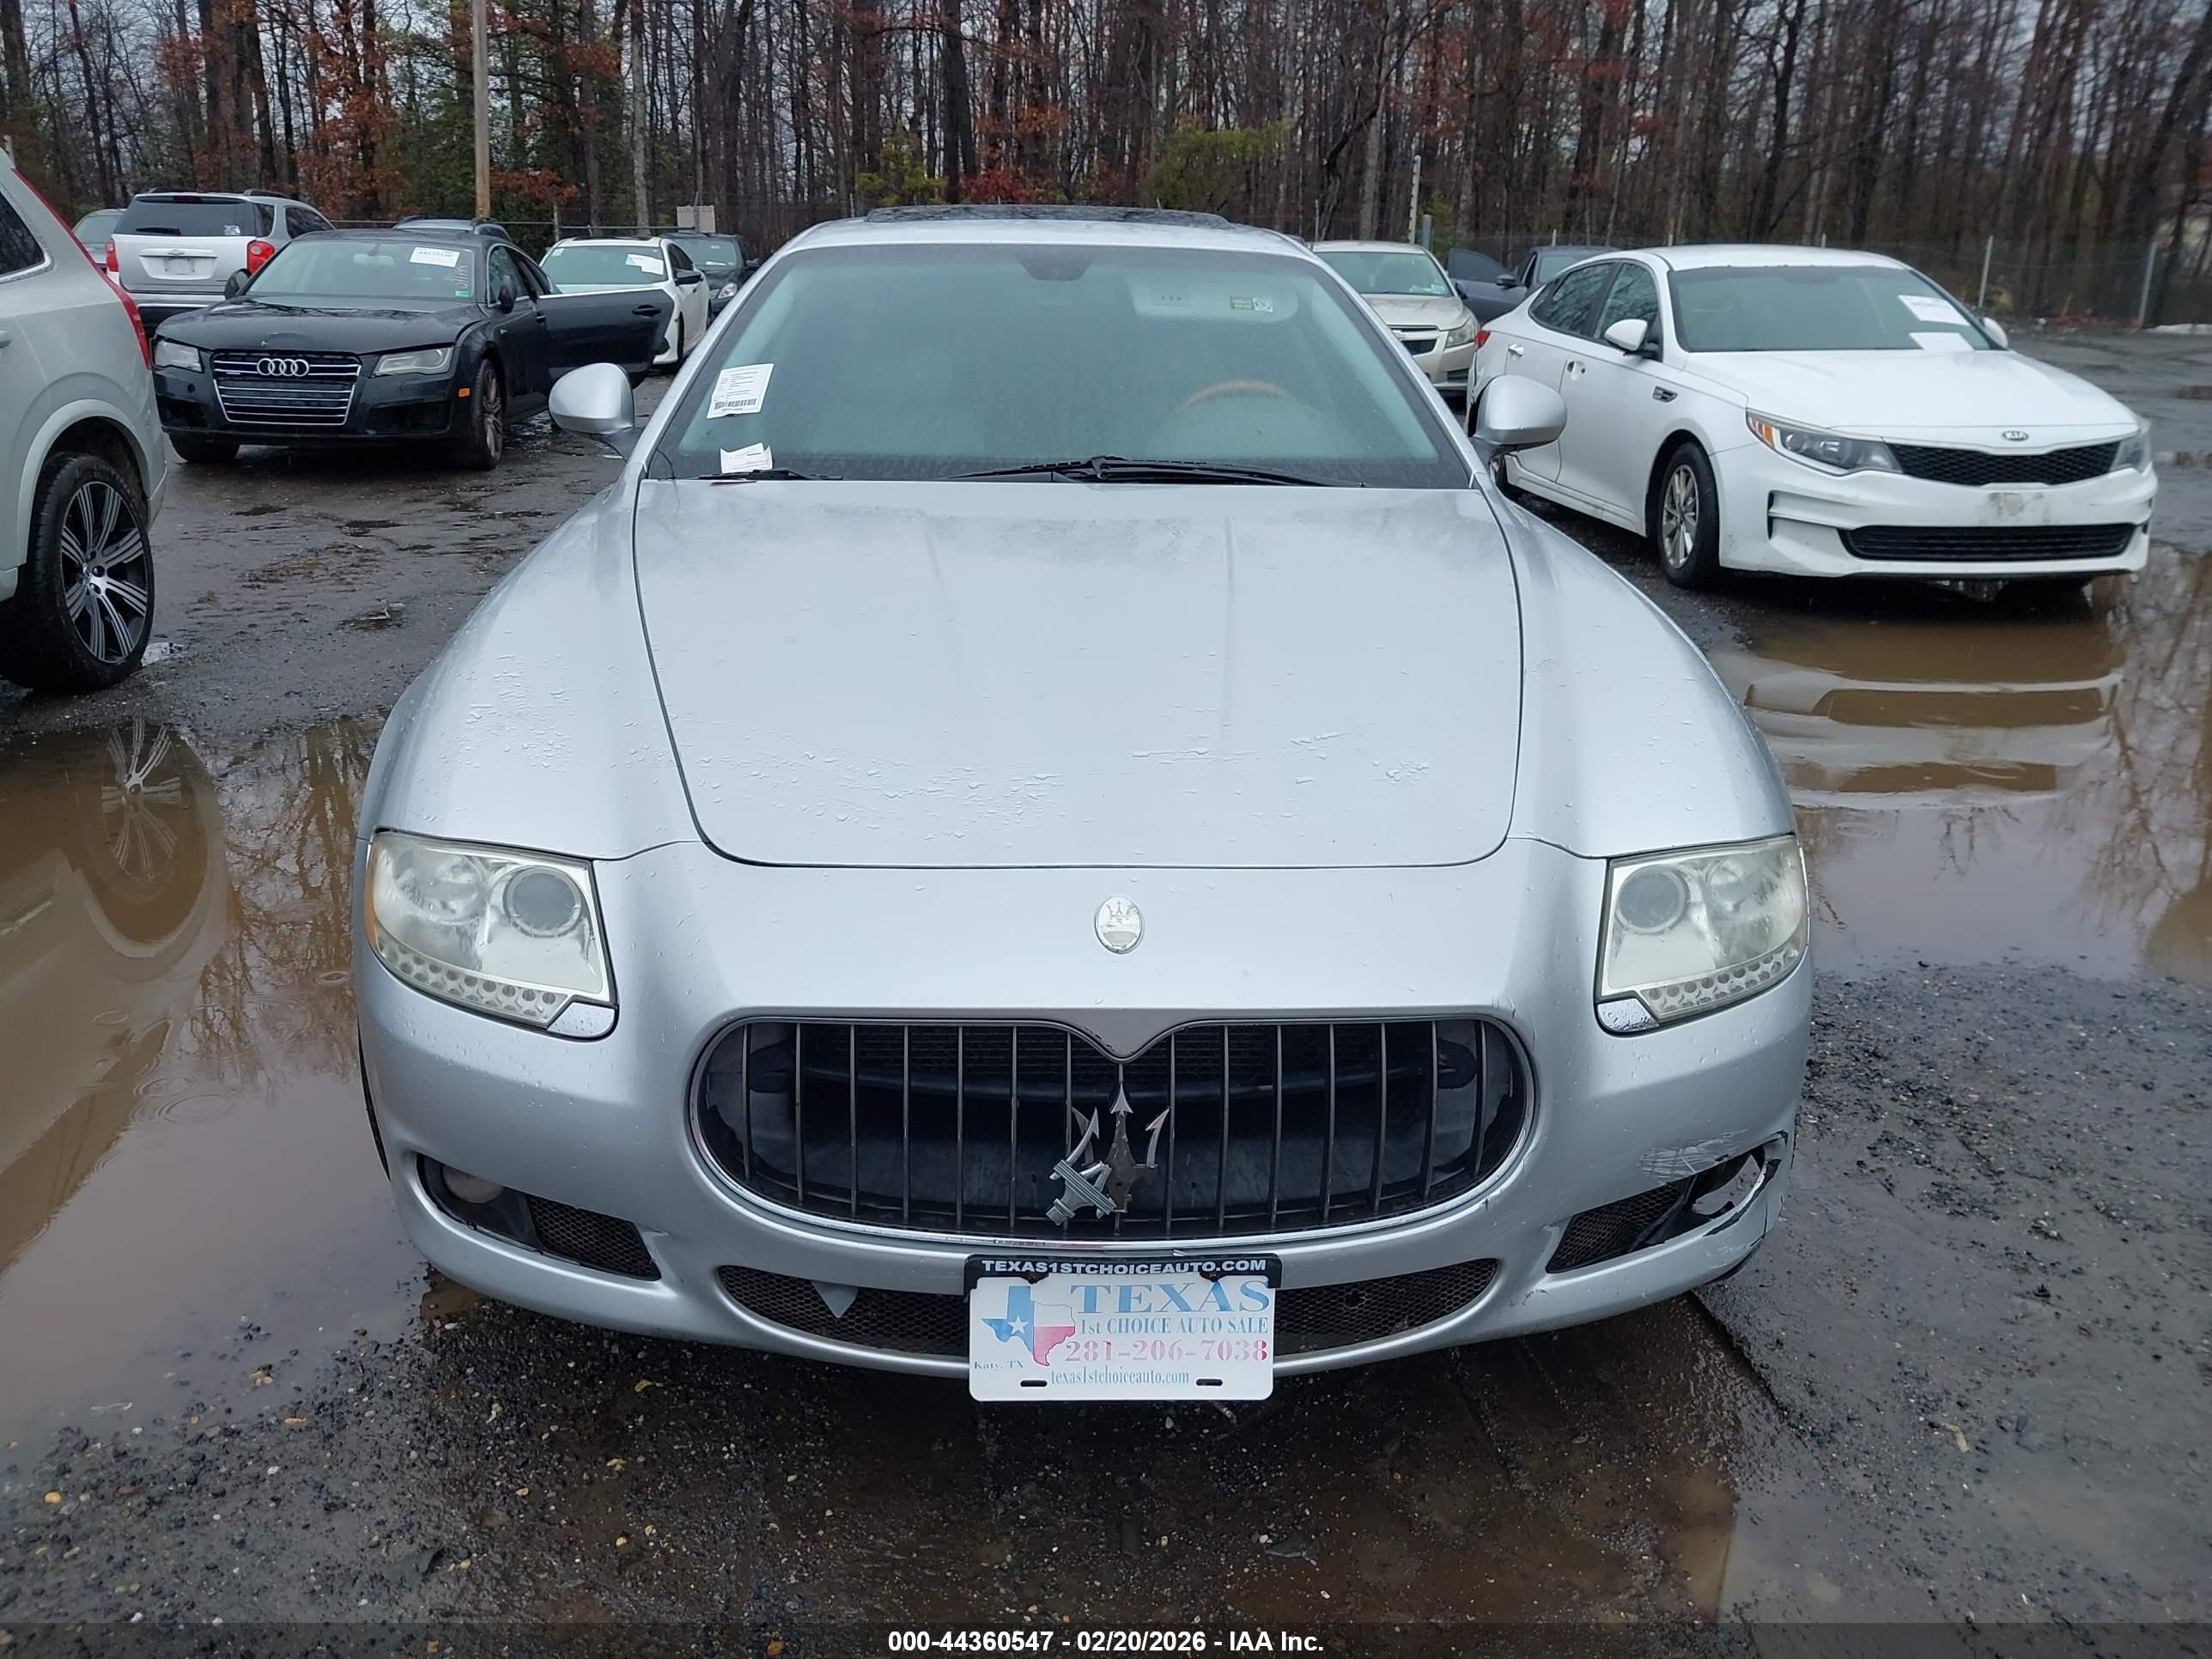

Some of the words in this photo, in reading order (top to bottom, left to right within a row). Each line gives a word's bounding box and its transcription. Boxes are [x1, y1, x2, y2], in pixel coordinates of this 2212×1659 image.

[981, 1259, 1267, 1275] TEXAS1STCHOICEAUTO.COM
[1070, 1279, 1271, 1314] TEXAS
[1080, 1318, 1101, 1335] 1st
[1107, 1317, 1171, 1334] CHOICE
[1179, 1317, 1224, 1334] AUTO
[1227, 1317, 1268, 1334] SALE
[1065, 1339, 1268, 1362] 281-206-7038
[1007, 1359, 1024, 1369] TX
[1050, 1365, 1189, 1385] texas1stchoiceauto.com
